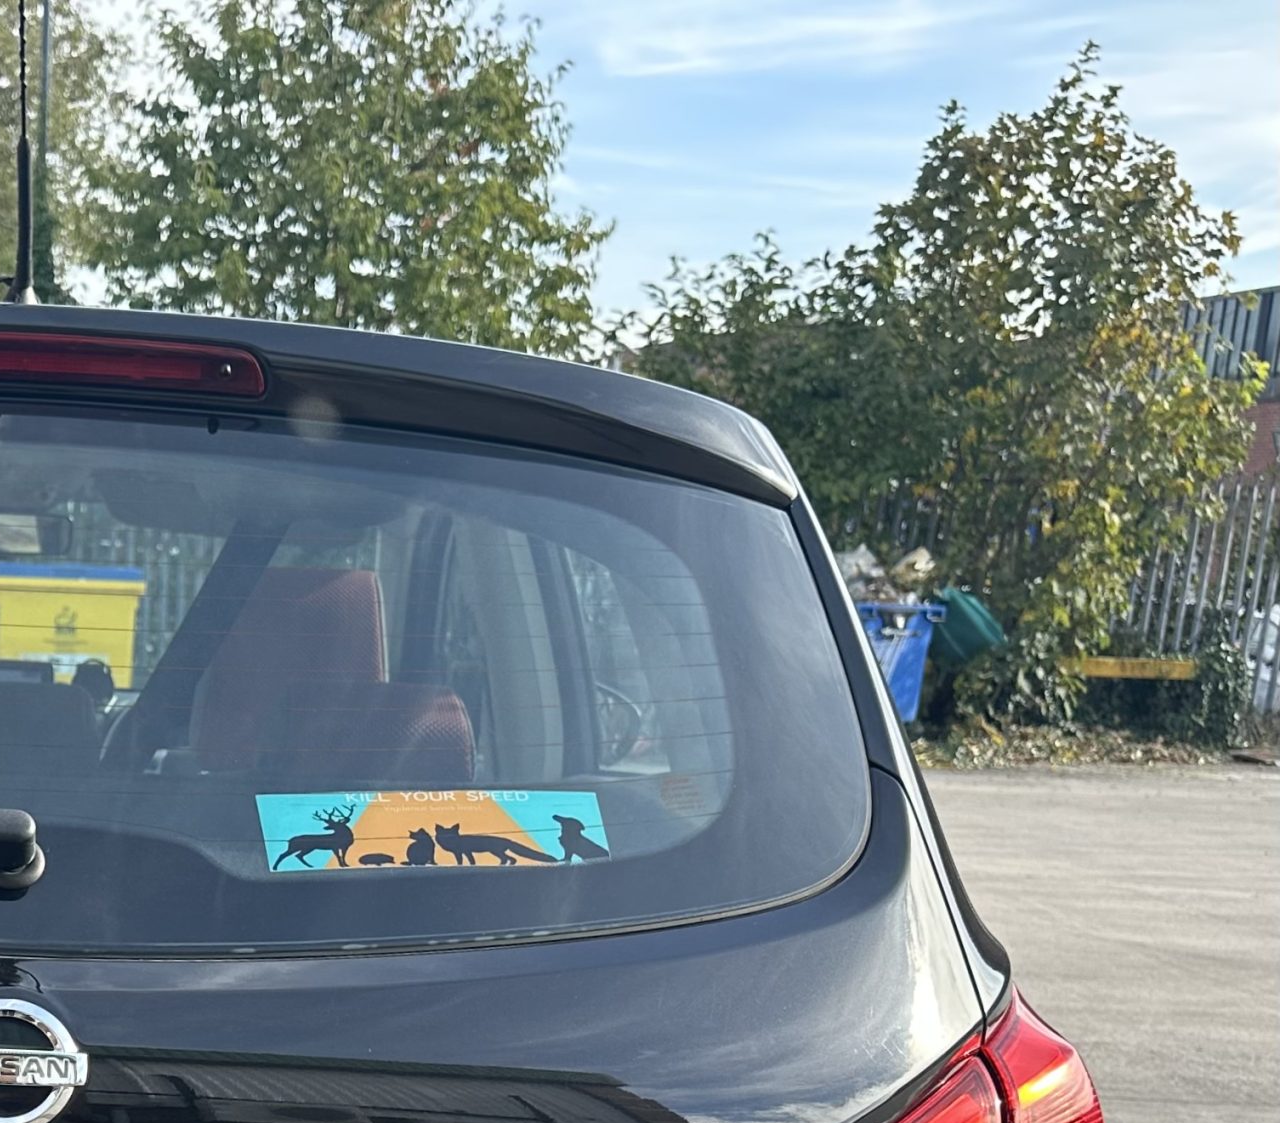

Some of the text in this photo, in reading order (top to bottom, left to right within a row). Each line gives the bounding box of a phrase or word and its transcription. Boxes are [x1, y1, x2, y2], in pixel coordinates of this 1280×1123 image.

[344, 790, 529, 803] KILL YOUR SPEED
